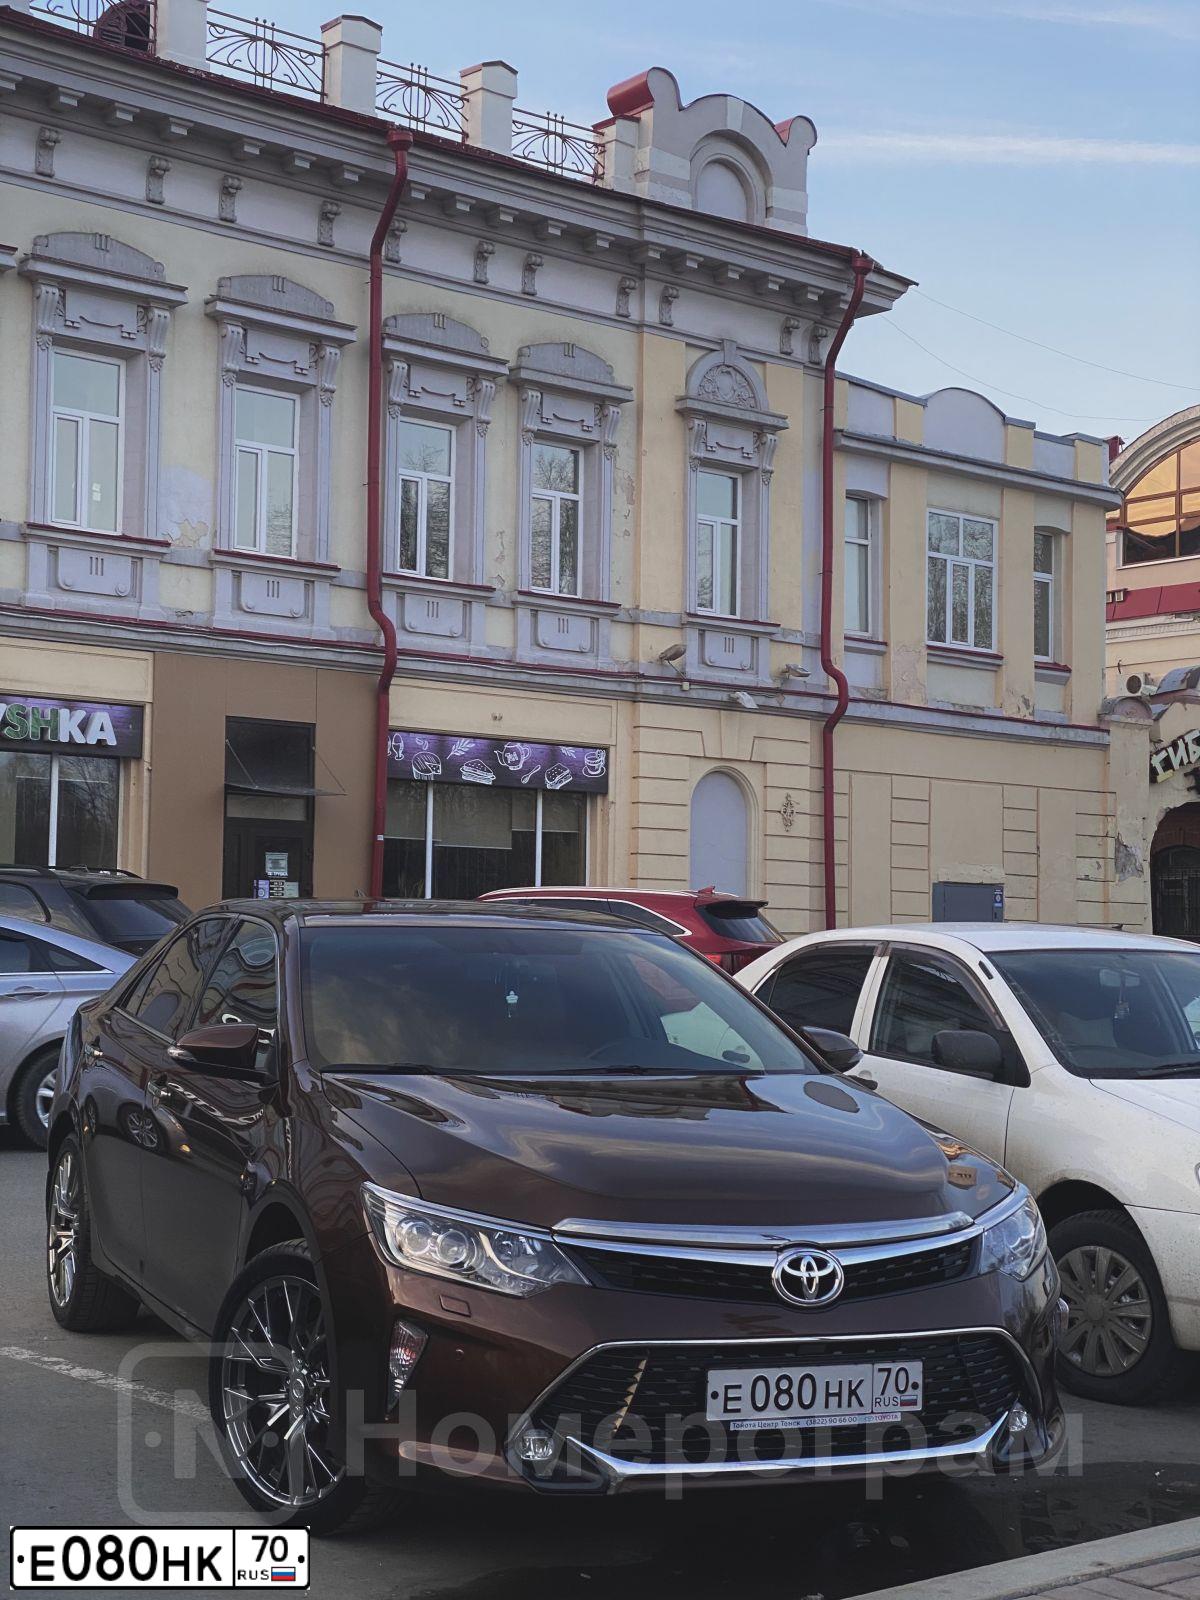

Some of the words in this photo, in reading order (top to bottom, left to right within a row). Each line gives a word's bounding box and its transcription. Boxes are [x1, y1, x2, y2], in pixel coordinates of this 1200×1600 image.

[722, 1372, 865, 1415] Е080НК
[876, 1366, 910, 1397] 70
[874, 1396, 899, 1409] RUS
[757, 1421, 779, 1429] Центр
[805, 1417, 828, 1426] (3822)
[875, 1413, 898, 1421] TOYOTA
